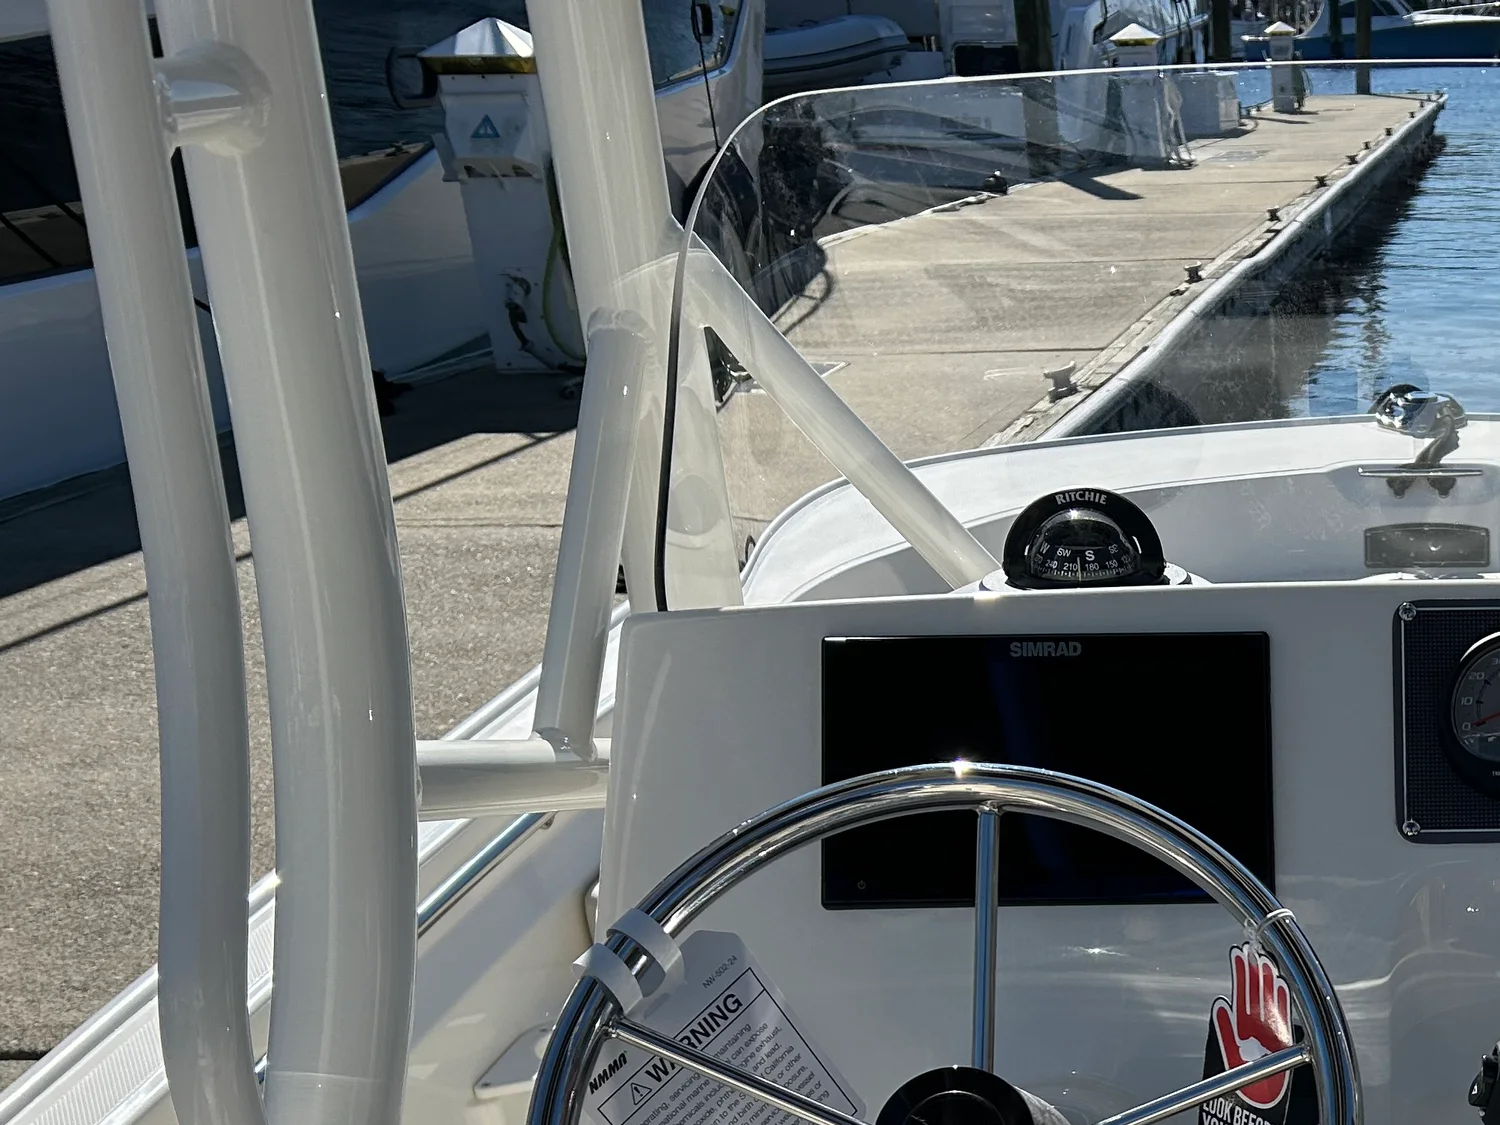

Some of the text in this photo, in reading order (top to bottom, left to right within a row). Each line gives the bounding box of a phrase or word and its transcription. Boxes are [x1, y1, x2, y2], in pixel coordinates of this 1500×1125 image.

[1055, 490, 1108, 505] RITCHIE
[1085, 550, 1095, 560] S
[1010, 642, 1082, 657] SIMRAD
[1468, 672, 1485, 680] 20
[1460, 697, 1473, 705] 10
[703, 955, 737, 988] NW-502-24
[1202, 1098, 1232, 1123] LOOK
